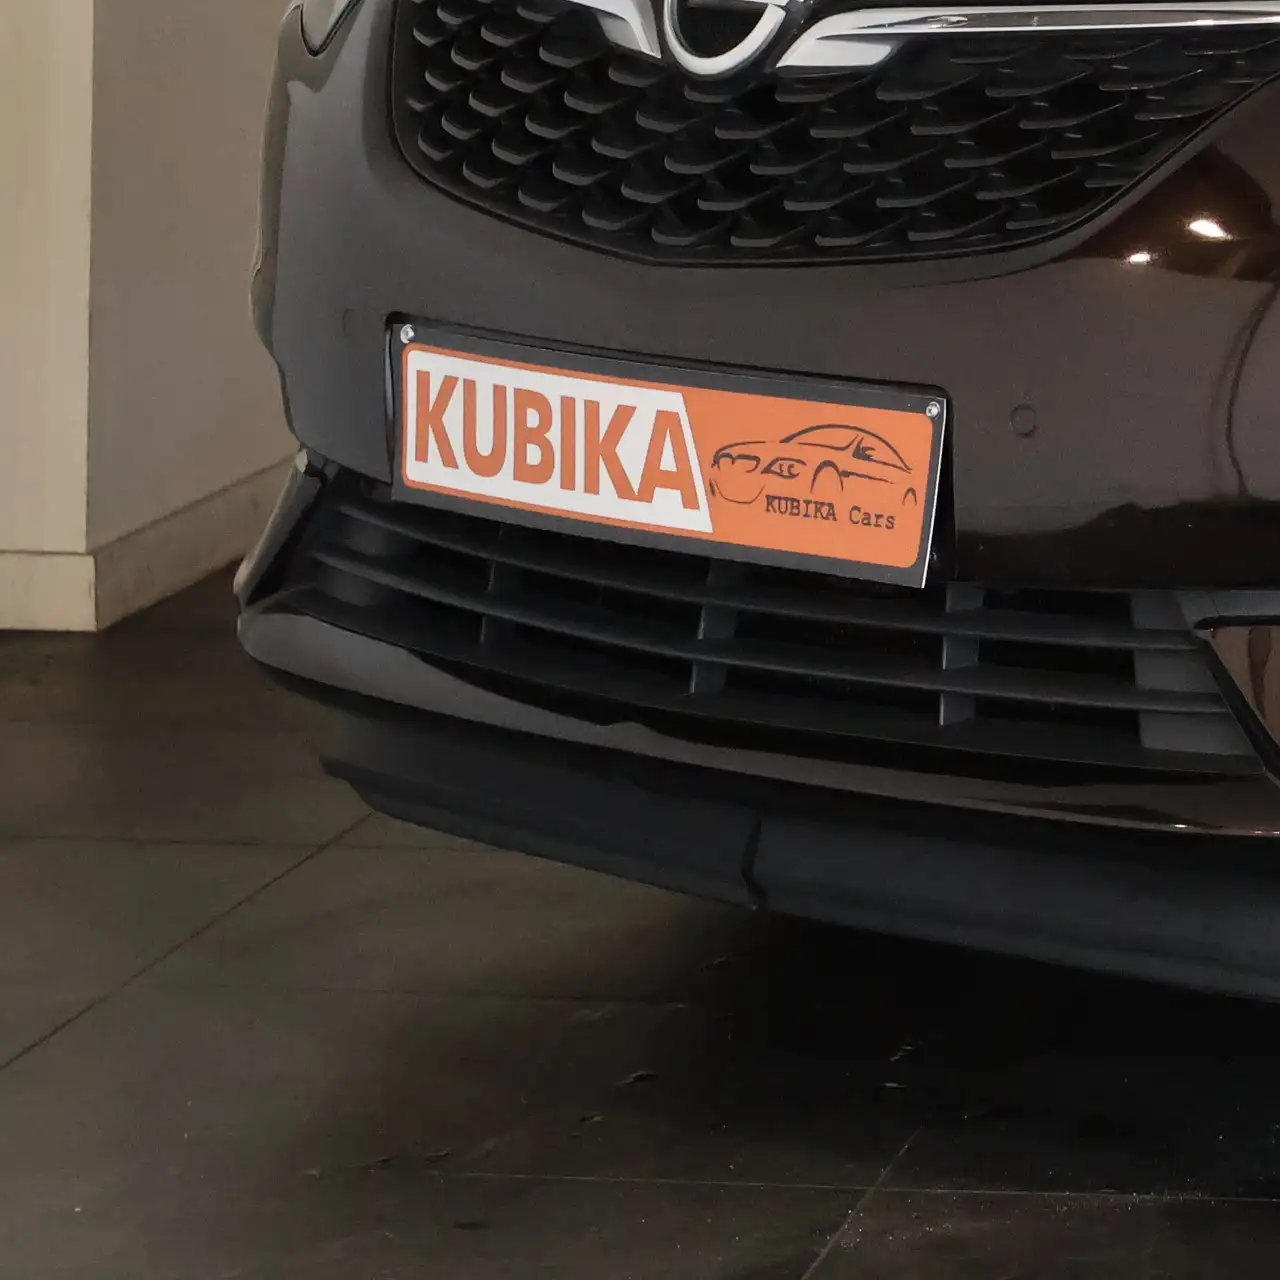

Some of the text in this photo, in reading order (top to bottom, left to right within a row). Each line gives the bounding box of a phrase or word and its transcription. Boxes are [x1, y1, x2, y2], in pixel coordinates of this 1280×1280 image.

[415, 370, 699, 510] KUBIKA
[765, 494, 895, 530] KUBIKA Cars
